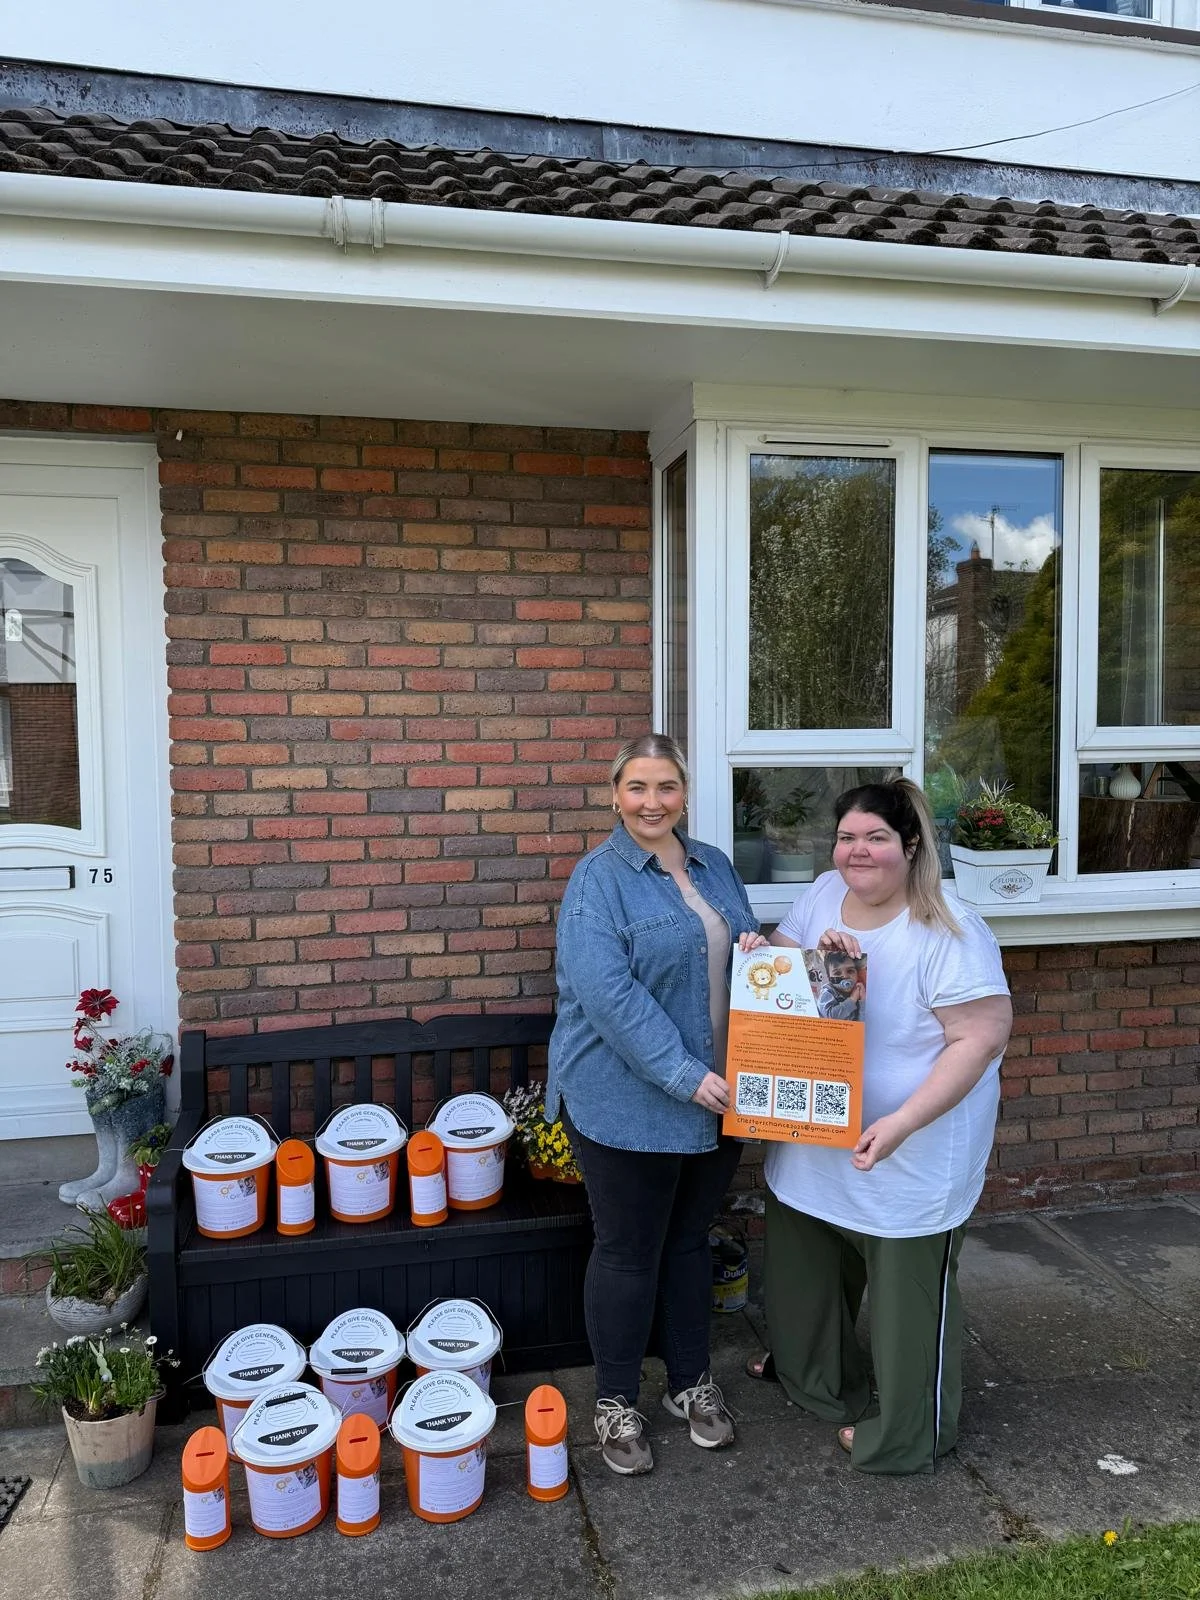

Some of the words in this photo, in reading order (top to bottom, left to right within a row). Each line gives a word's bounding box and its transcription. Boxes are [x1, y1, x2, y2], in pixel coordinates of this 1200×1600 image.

[88, 868, 112, 884] 75
[998, 876, 1026, 884] FLOWERS
[778, 993, 791, 1001] CC
[444, 1106, 456, 1121] PLEASE
[469, 1101, 496, 1116] GENEROUSLY
[336, 1115, 350, 1132] PLEASE
[363, 1111, 389, 1128] GENEROUSLY
[204, 1129, 220, 1144] PLEASE
[235, 1124, 260, 1142] GENEROUSLY
[331, 1321, 347, 1338] PLEASE
[361, 1316, 388, 1336] GENEROUSLY
[428, 1311, 443, 1328] PLEASE
[457, 1308, 483, 1330] GENEROUSLY
[225, 1341, 240, 1361] PLEASE
[241, 1334, 254, 1342] GIVE
[255, 1333, 286, 1350] GENEROUSLY
[410, 1389, 423, 1411] PLEASE
[423, 1381, 436, 1390] GIVE
[437, 1380, 471, 1397] GENEROUSLY
[253, 1403, 267, 1425] PLEAS
[426, 1419, 446, 1427] THANK
[269, 1432, 292, 1442] THANK
[292, 1428, 307, 1436] YOU!
